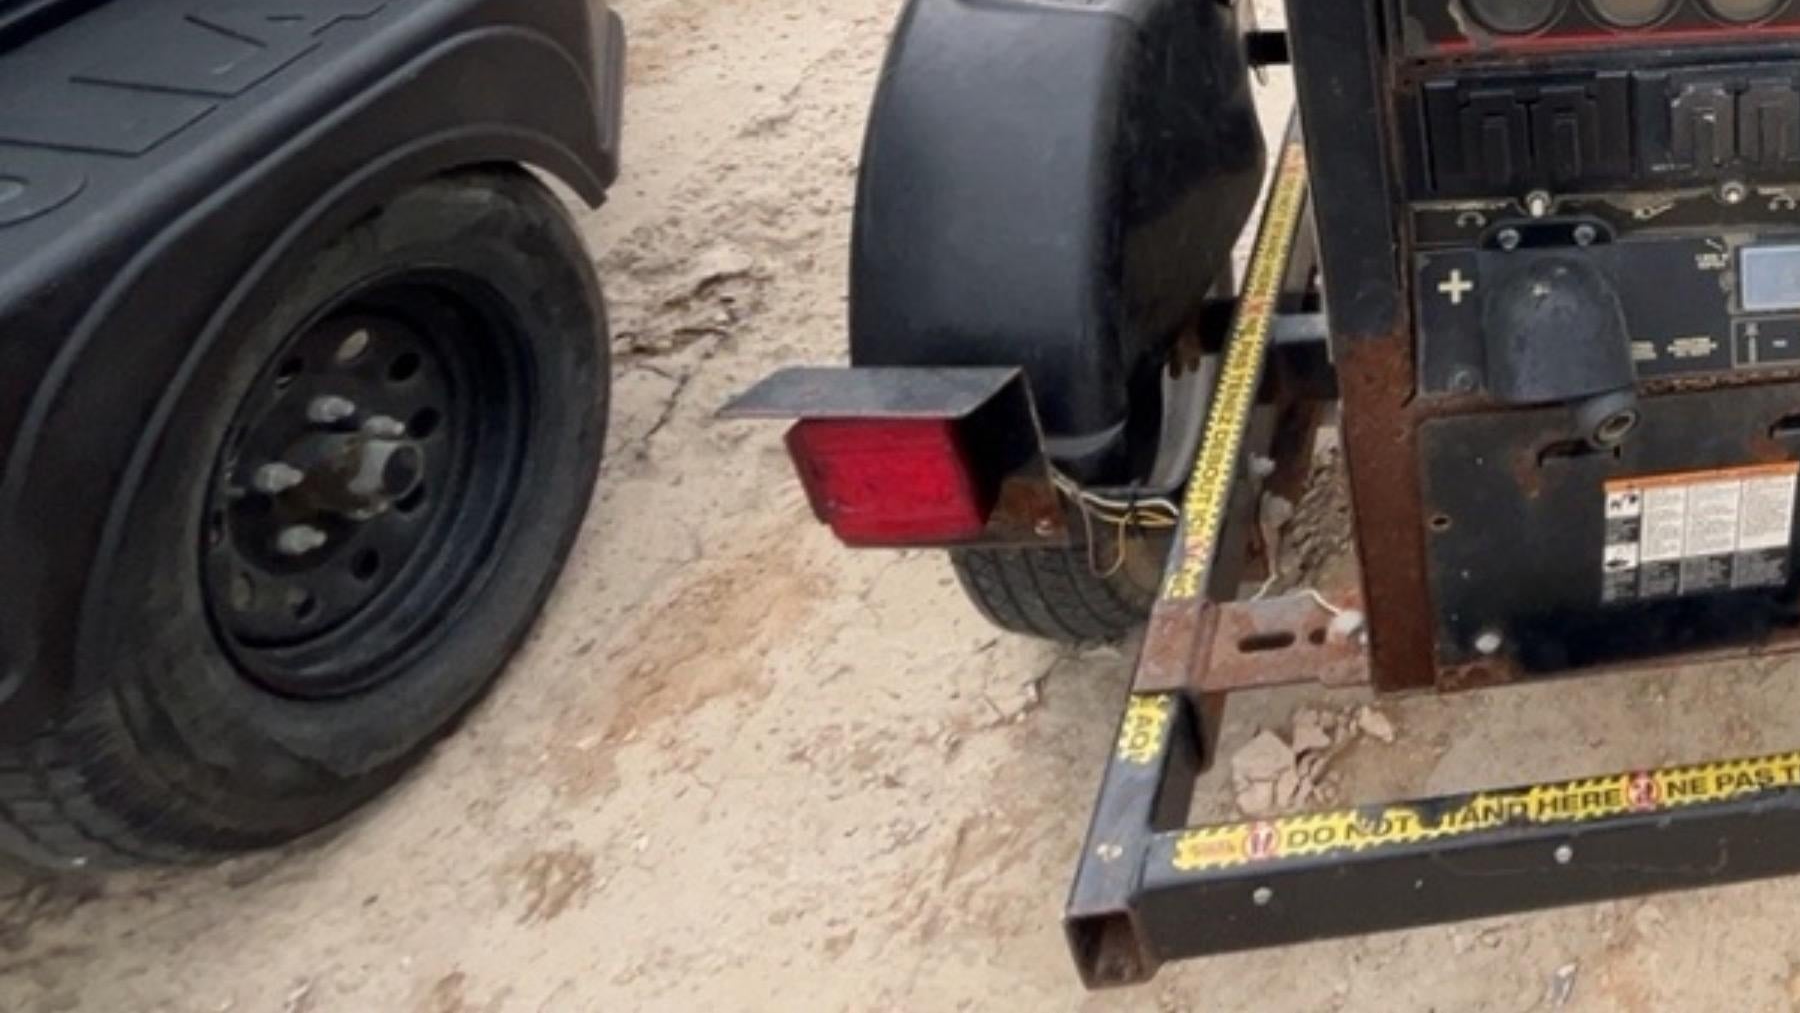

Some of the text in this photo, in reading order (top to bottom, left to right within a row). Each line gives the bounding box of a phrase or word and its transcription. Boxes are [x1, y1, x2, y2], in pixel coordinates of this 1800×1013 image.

[1667, 777, 1710, 798] NE
[1715, 770, 1777, 793] PAS
[1286, 826, 1337, 849] DO
[1535, 788, 1625, 818] HERE
